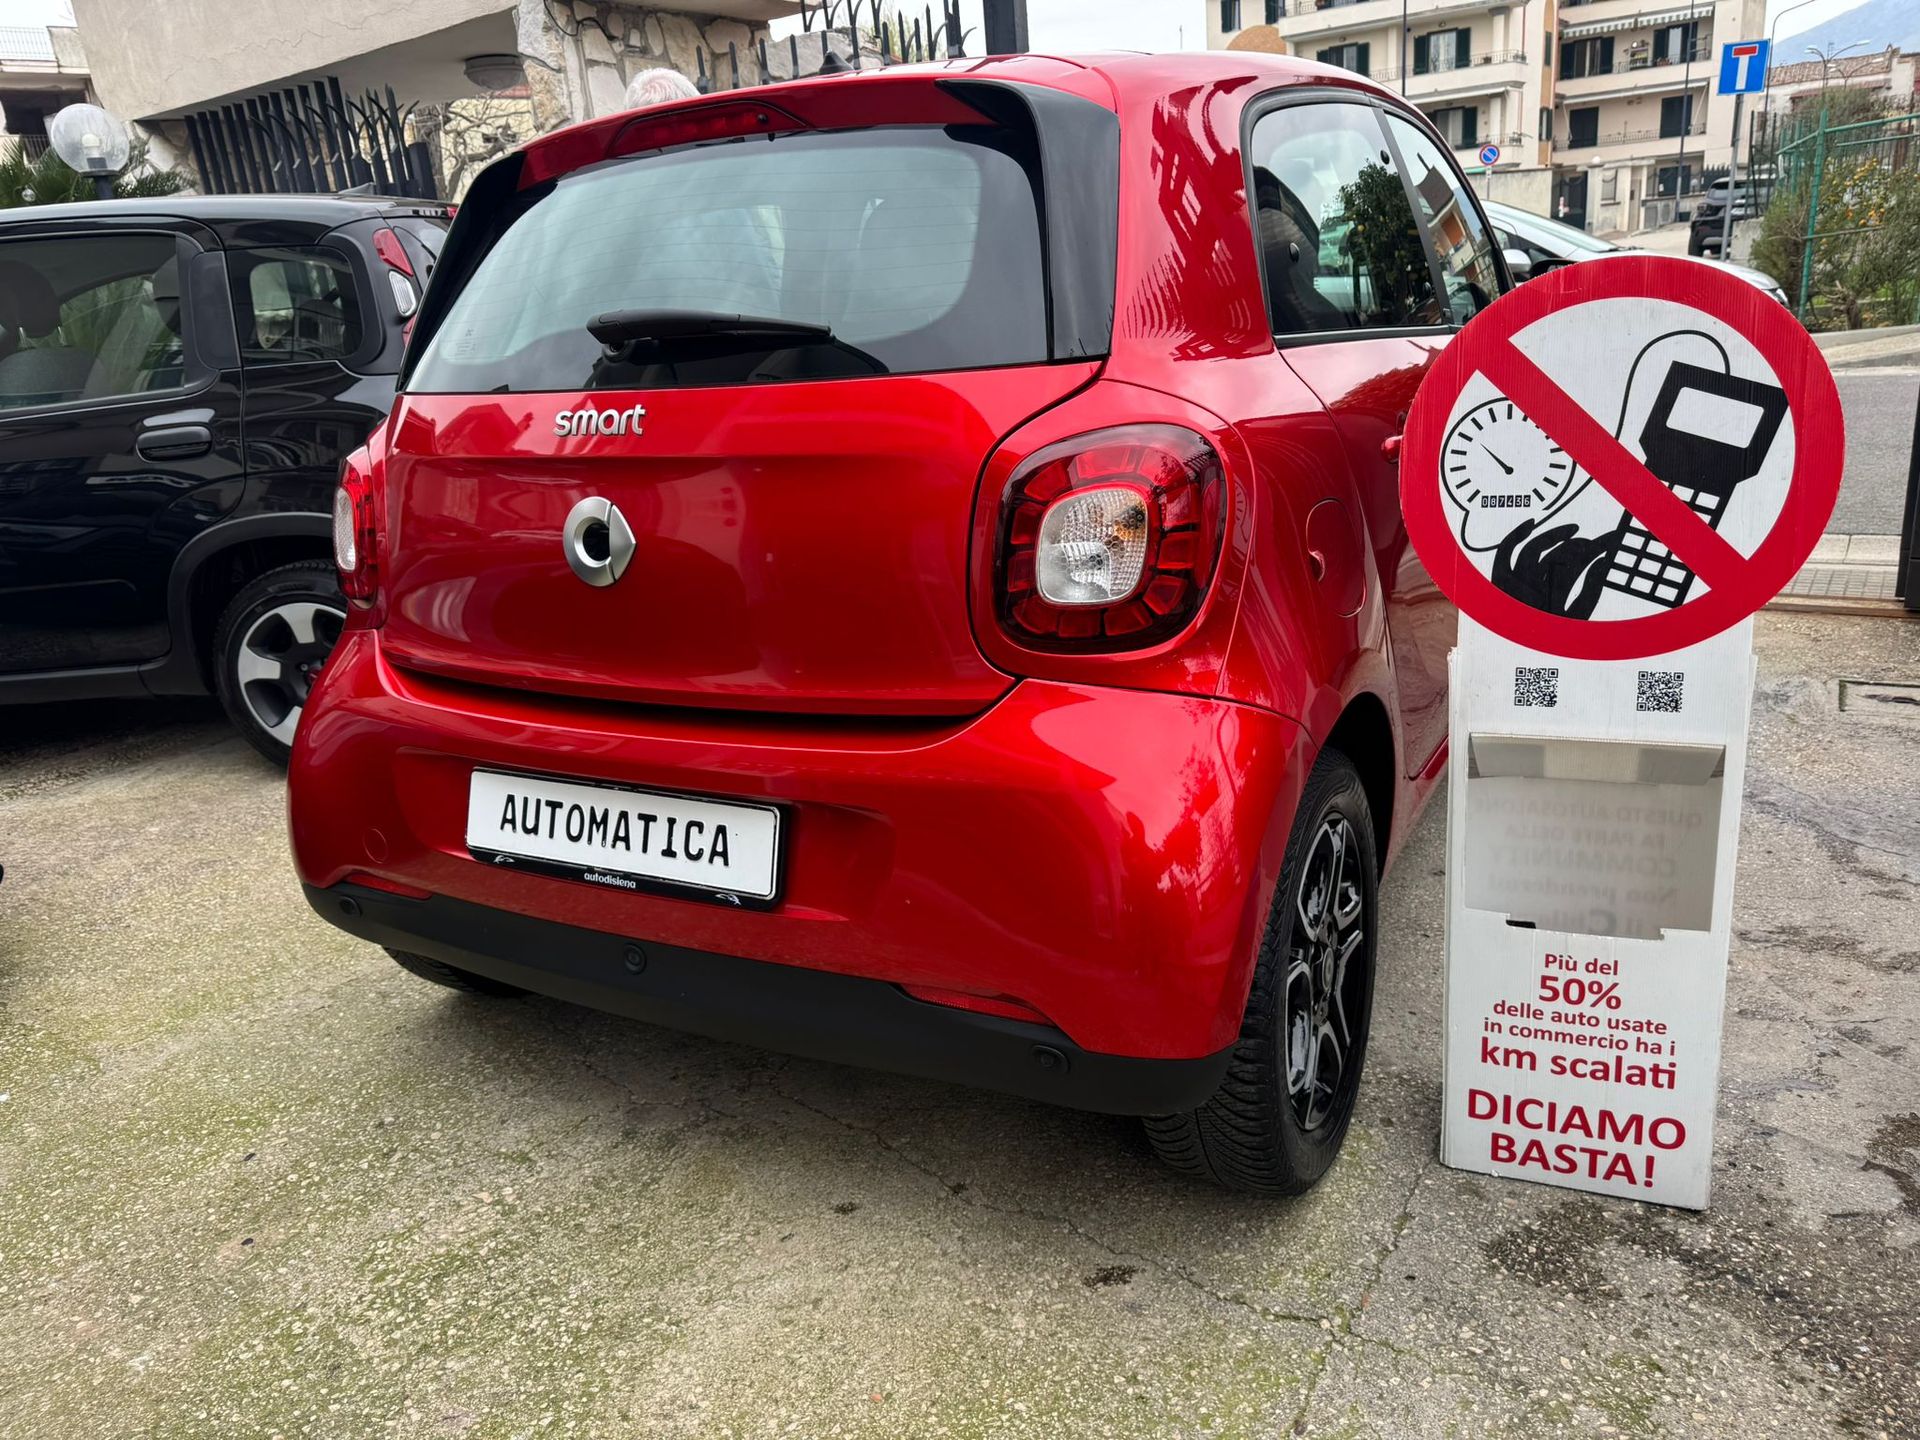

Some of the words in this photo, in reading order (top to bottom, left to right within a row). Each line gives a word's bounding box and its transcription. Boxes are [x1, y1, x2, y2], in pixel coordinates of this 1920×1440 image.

[553, 404, 645, 436] smart
[500, 793, 731, 867] AUTOMATICA
[1544, 953, 1578, 972] Più
[1585, 960, 1619, 976] del
[1539, 975, 1622, 1010] 50%
[1484, 1017, 1502, 1033] in
[1509, 1022, 1628, 1051] commercio
[1636, 1037, 1663, 1055] ha
[1669, 1041, 1676, 1056] i
[1493, 1000, 1544, 1020] delle
[1551, 1011, 1600, 1028] auto
[1607, 1018, 1668, 1035] usate
[1481, 1036, 1537, 1071] km
[1550, 1055, 1677, 1090] scalati
[1467, 1088, 1687, 1150] DICIAMO
[1490, 1131, 1656, 1188] BASTA!
